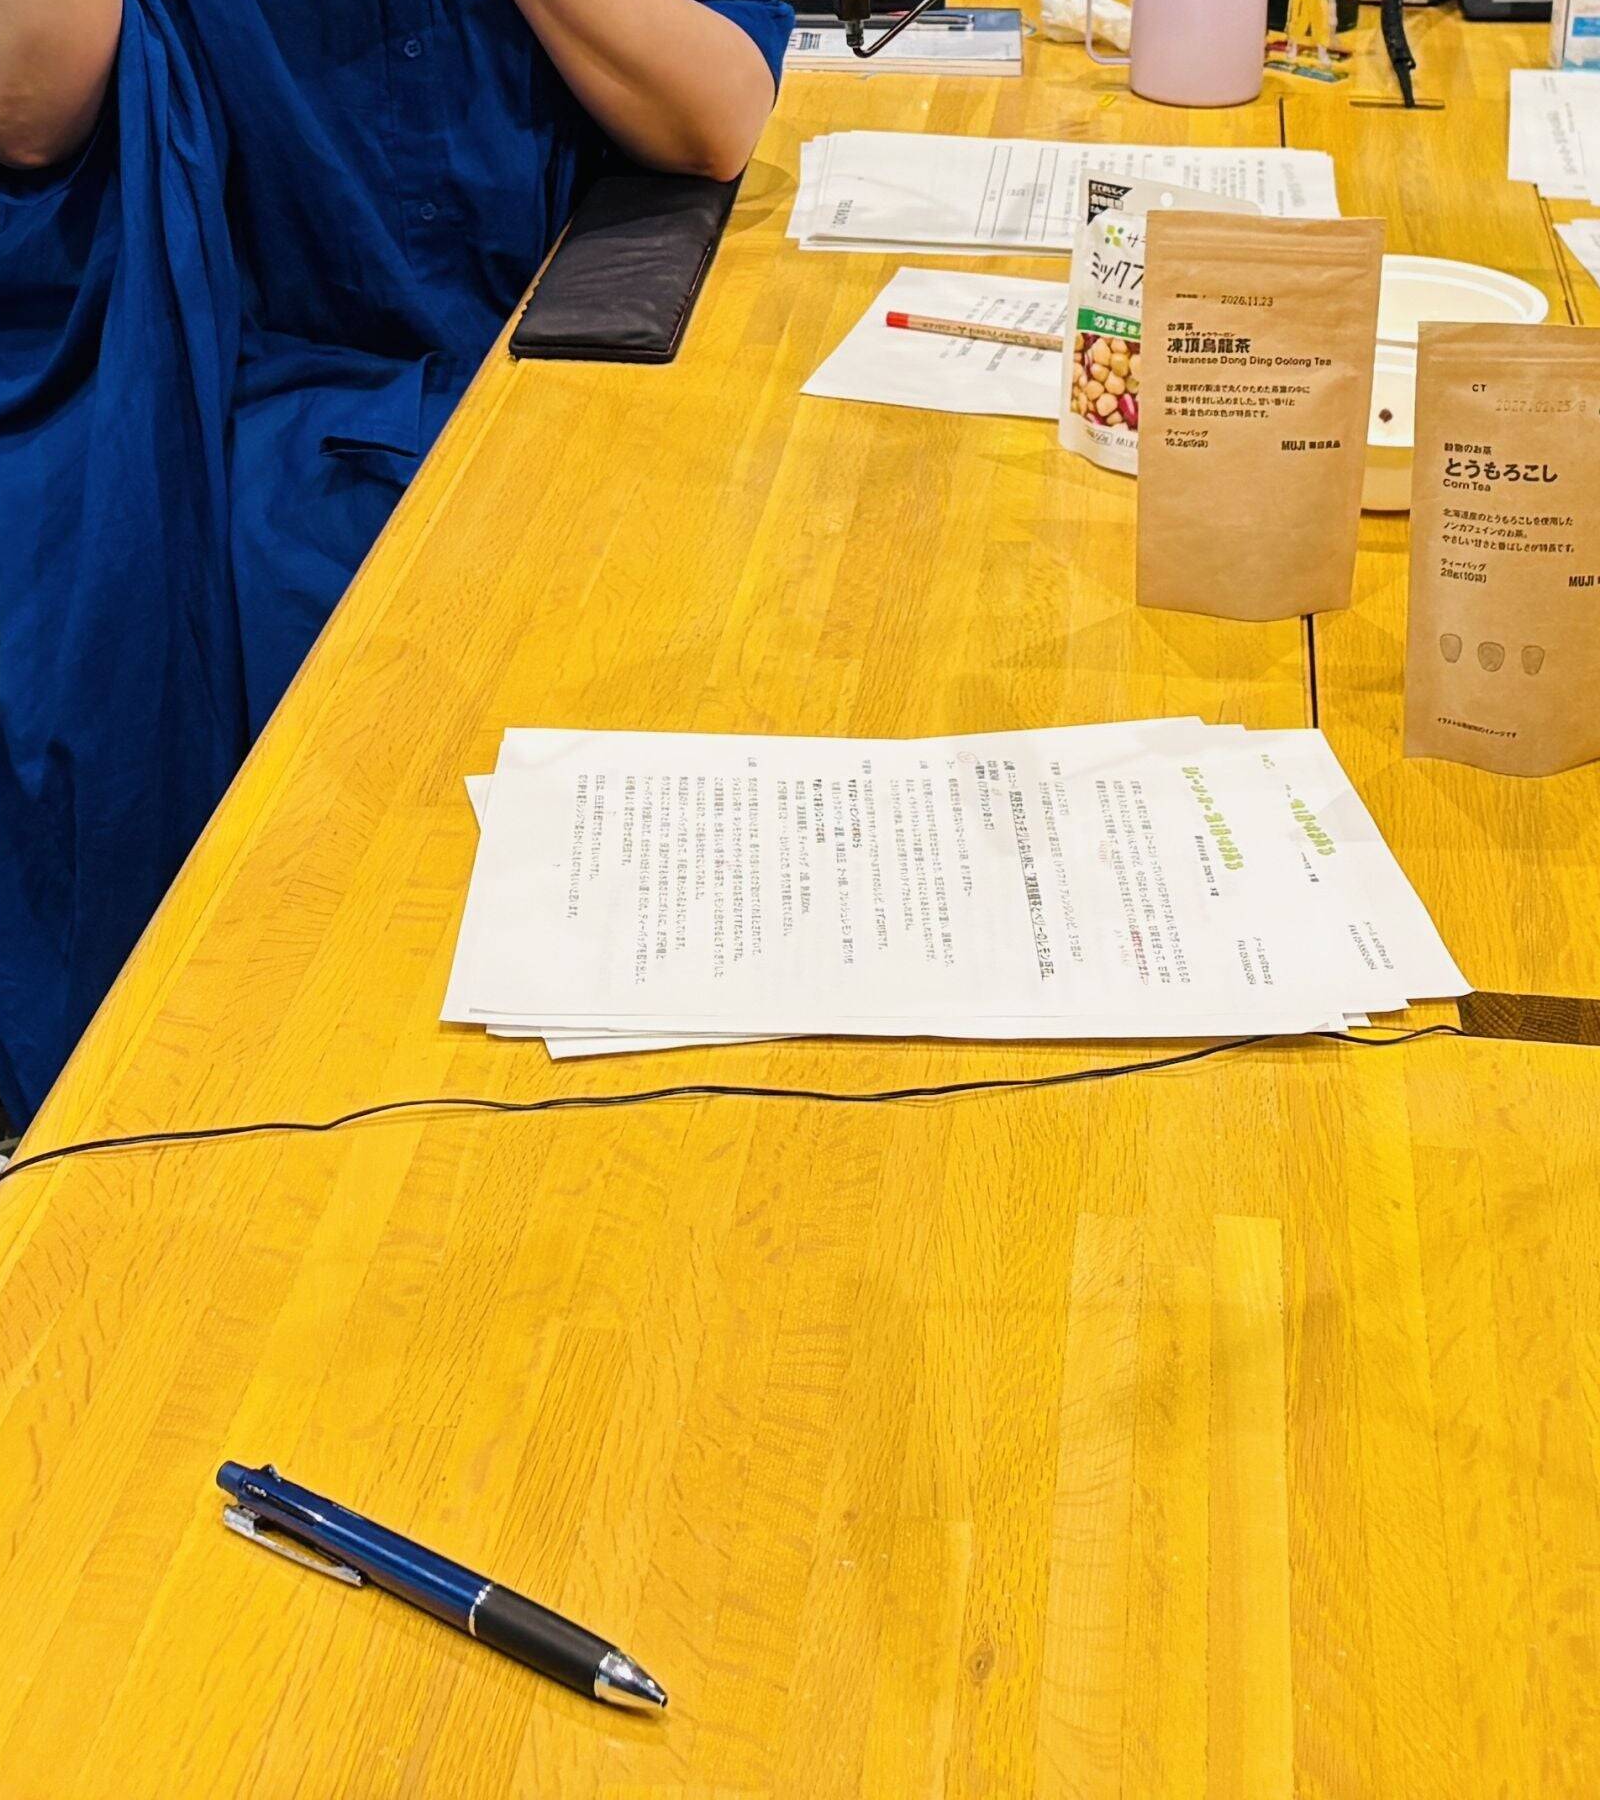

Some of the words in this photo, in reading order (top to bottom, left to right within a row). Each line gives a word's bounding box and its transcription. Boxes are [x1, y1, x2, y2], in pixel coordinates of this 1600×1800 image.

[1167, 338, 1251, 353] 凍頂烏龍茶
[1167, 356, 1219, 364] Taiwanese
[1220, 356, 1247, 366] Dong
[1250, 357, 1273, 367] Ding
[1314, 357, 1331, 366] Tea
[1281, 440, 1306, 451] MUJI
[1445, 458, 1559, 483] とうもろこし
[1442, 478, 1470, 490] Corn
[1472, 481, 1491, 492] Tea
[1568, 575, 1594, 587] MUJI
